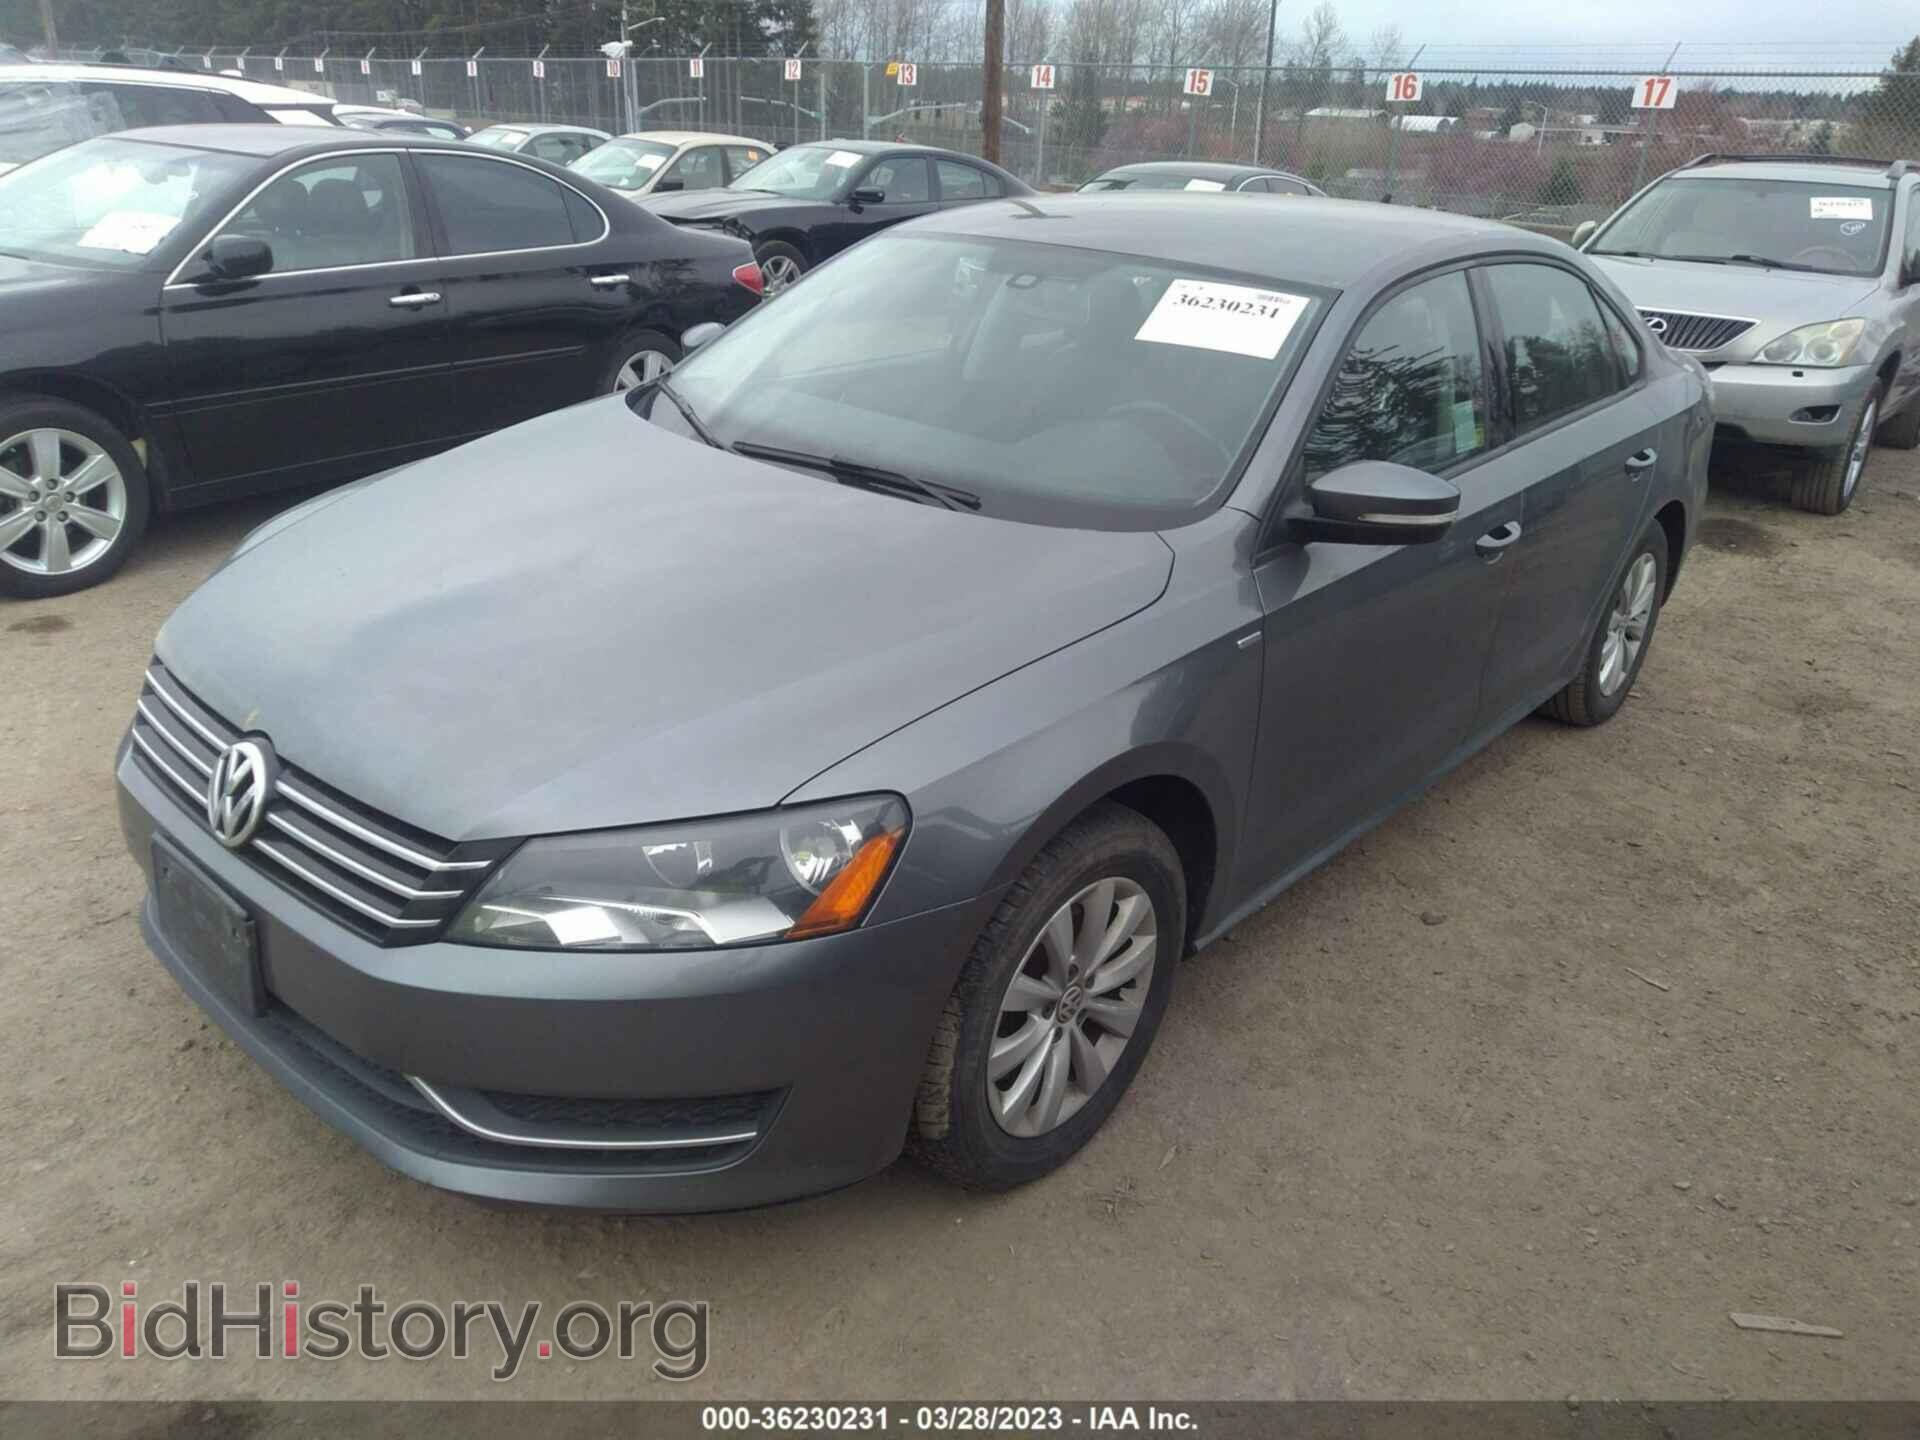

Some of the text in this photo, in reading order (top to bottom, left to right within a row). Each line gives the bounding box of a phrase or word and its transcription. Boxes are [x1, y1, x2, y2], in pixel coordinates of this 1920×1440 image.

[788, 60, 798, 77] 12
[900, 64, 913, 84] 13
[1035, 66, 1052, 87] 14
[1190, 70, 1209, 93] 15
[1393, 74, 1418, 99] 16
[1643, 78, 1671, 107] 17
[1173, 294, 1279, 318] 36230231
